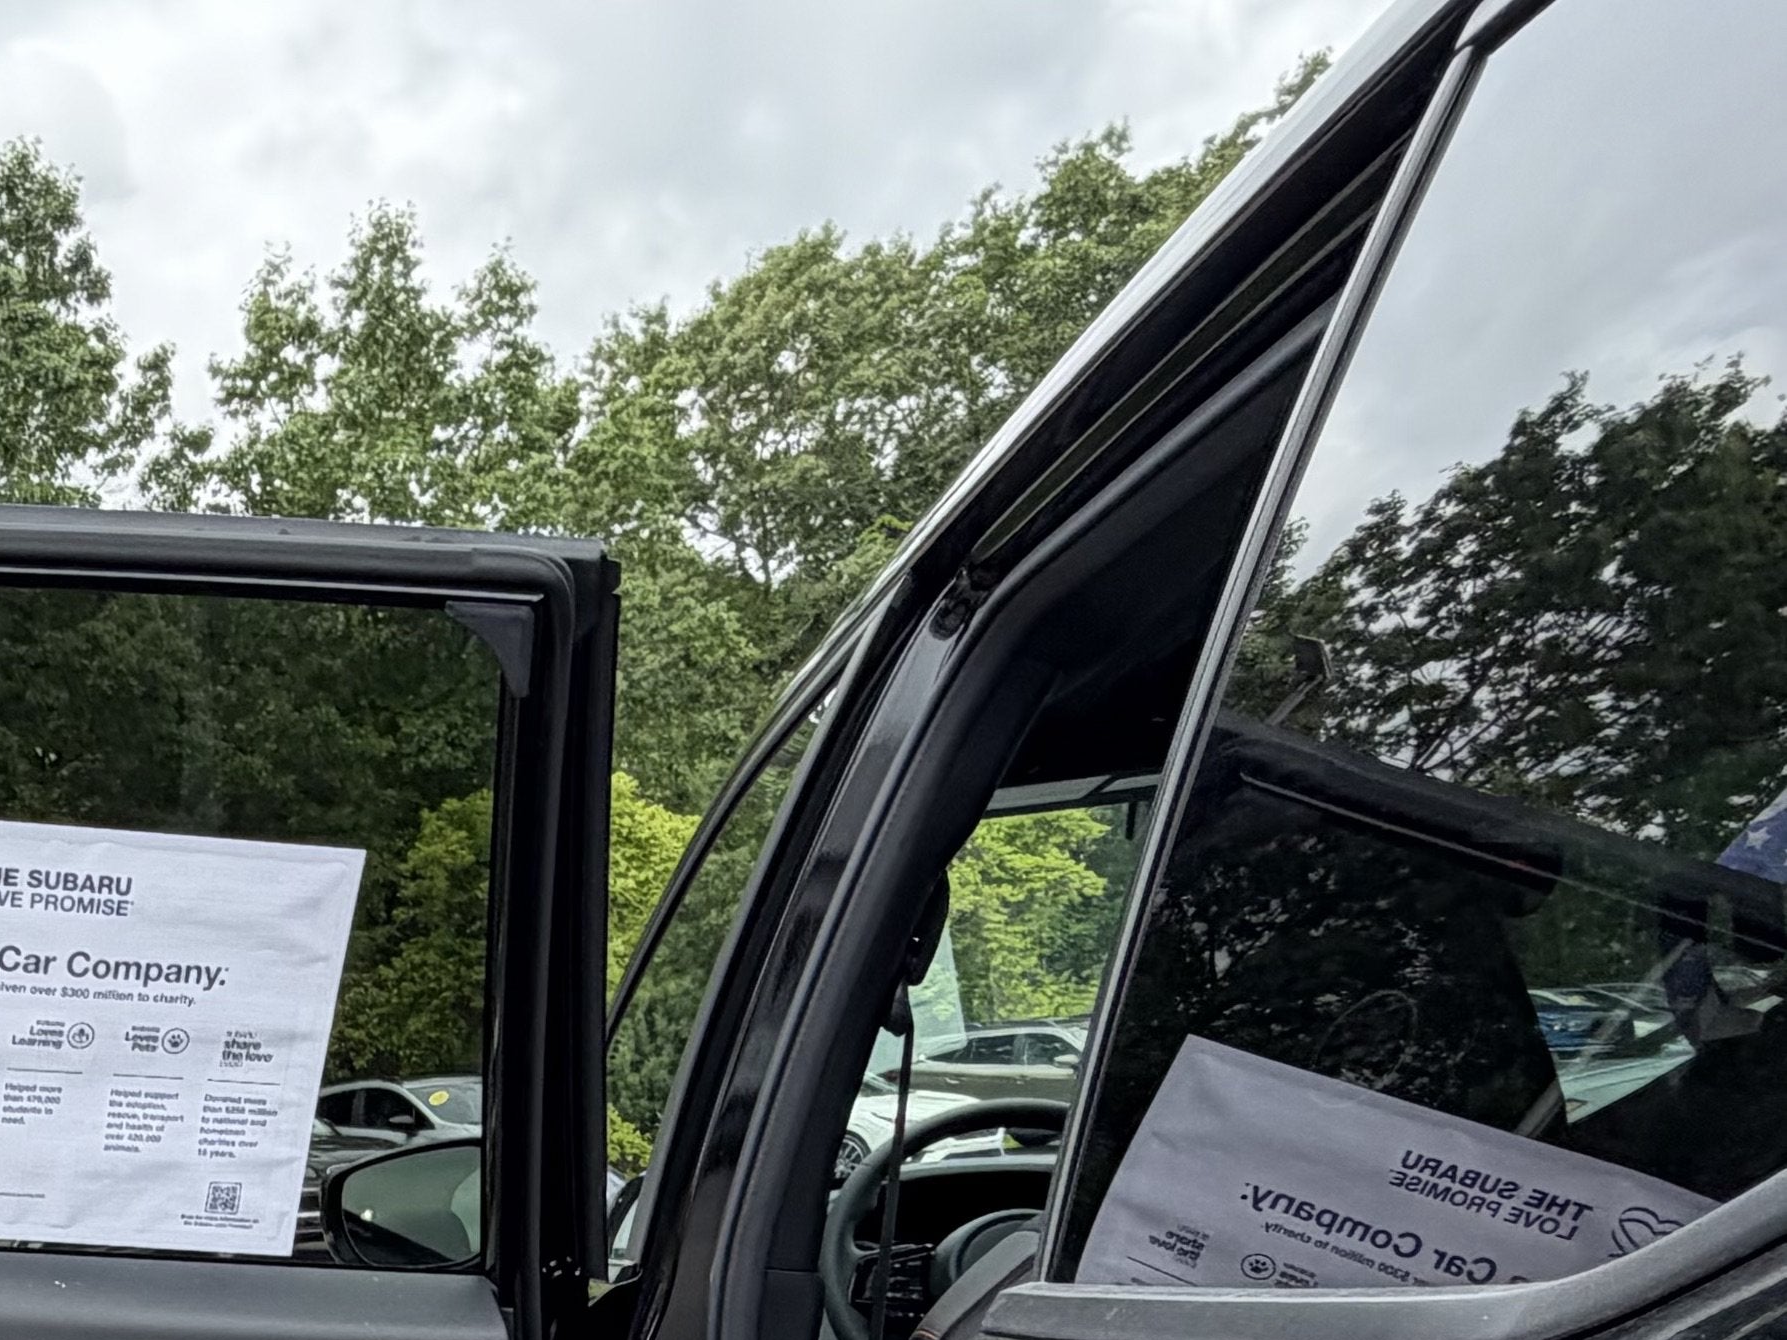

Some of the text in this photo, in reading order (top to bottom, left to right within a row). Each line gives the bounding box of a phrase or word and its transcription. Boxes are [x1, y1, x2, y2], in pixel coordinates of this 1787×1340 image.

[26, 869, 133, 896] SUBARU
[29, 892, 134, 917] PROMISE
[30, 987, 57, 996] over
[61, 986, 90, 999] $300
[93, 989, 134, 1002] million
[137, 991, 150, 1002] to
[153, 993, 196, 1008] charity.
[30, 1026, 64, 1037] Loves
[125, 1032, 159, 1042] Loves
[12, 1035, 63, 1049] Learning
[132, 1042, 158, 1052] Pets
[223, 1039, 261, 1050] share
[222, 1050, 243, 1061] the
